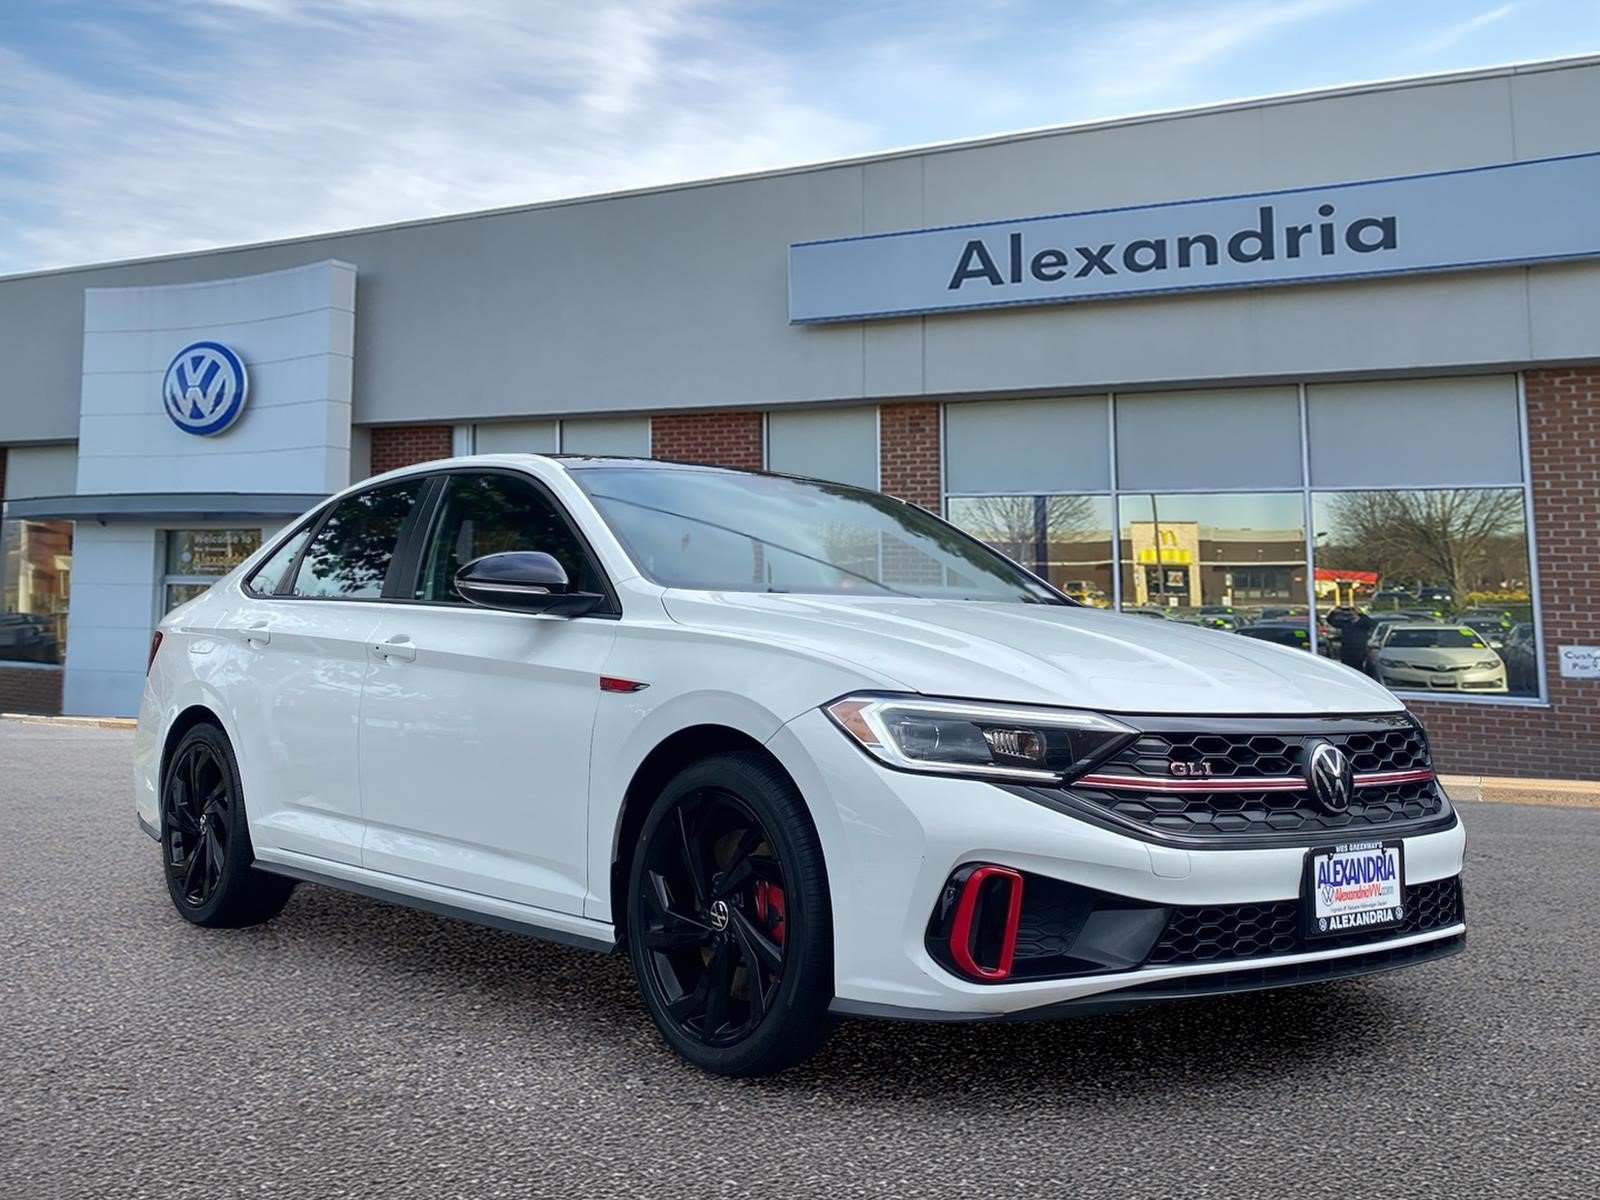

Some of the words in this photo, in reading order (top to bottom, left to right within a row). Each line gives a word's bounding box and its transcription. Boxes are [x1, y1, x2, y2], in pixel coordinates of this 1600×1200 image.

[947, 203, 1398, 290] Alexandria
[194, 534, 238, 544] Welcome
[1170, 761, 1213, 776] GLI
[1317, 854, 1396, 889] ALEXANDRIA
[1329, 909, 1394, 930] ALEXANDRIA
